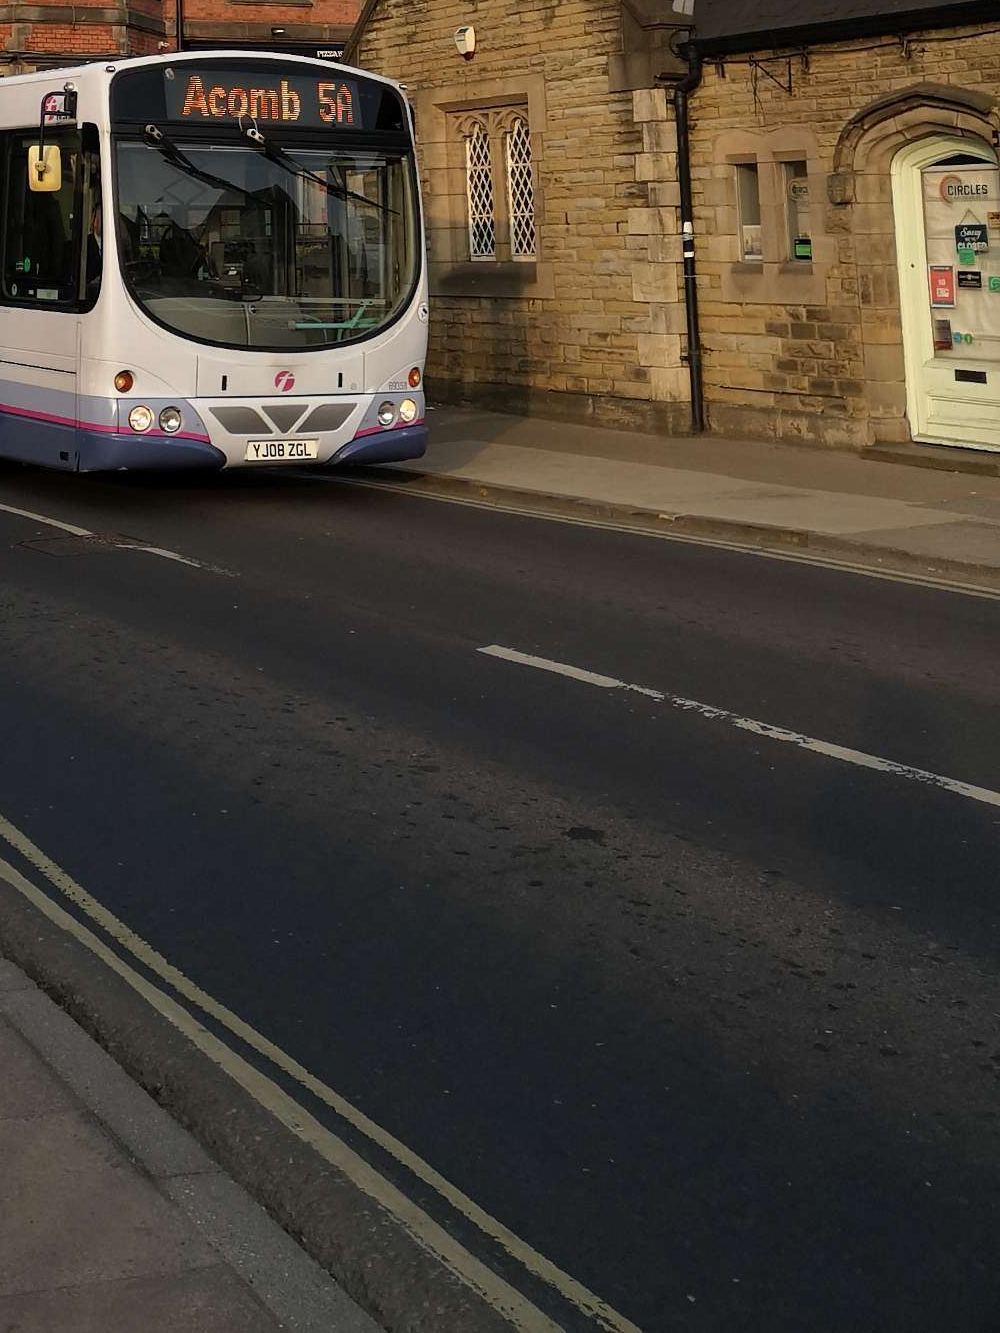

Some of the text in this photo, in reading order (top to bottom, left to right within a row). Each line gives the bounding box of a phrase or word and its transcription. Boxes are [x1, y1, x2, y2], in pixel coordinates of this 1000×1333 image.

[182, 74, 354, 123] Acomb 5A
[947, 184, 988, 195] CIRCLES
[253, 442, 312, 458] YJ08 ZGL
